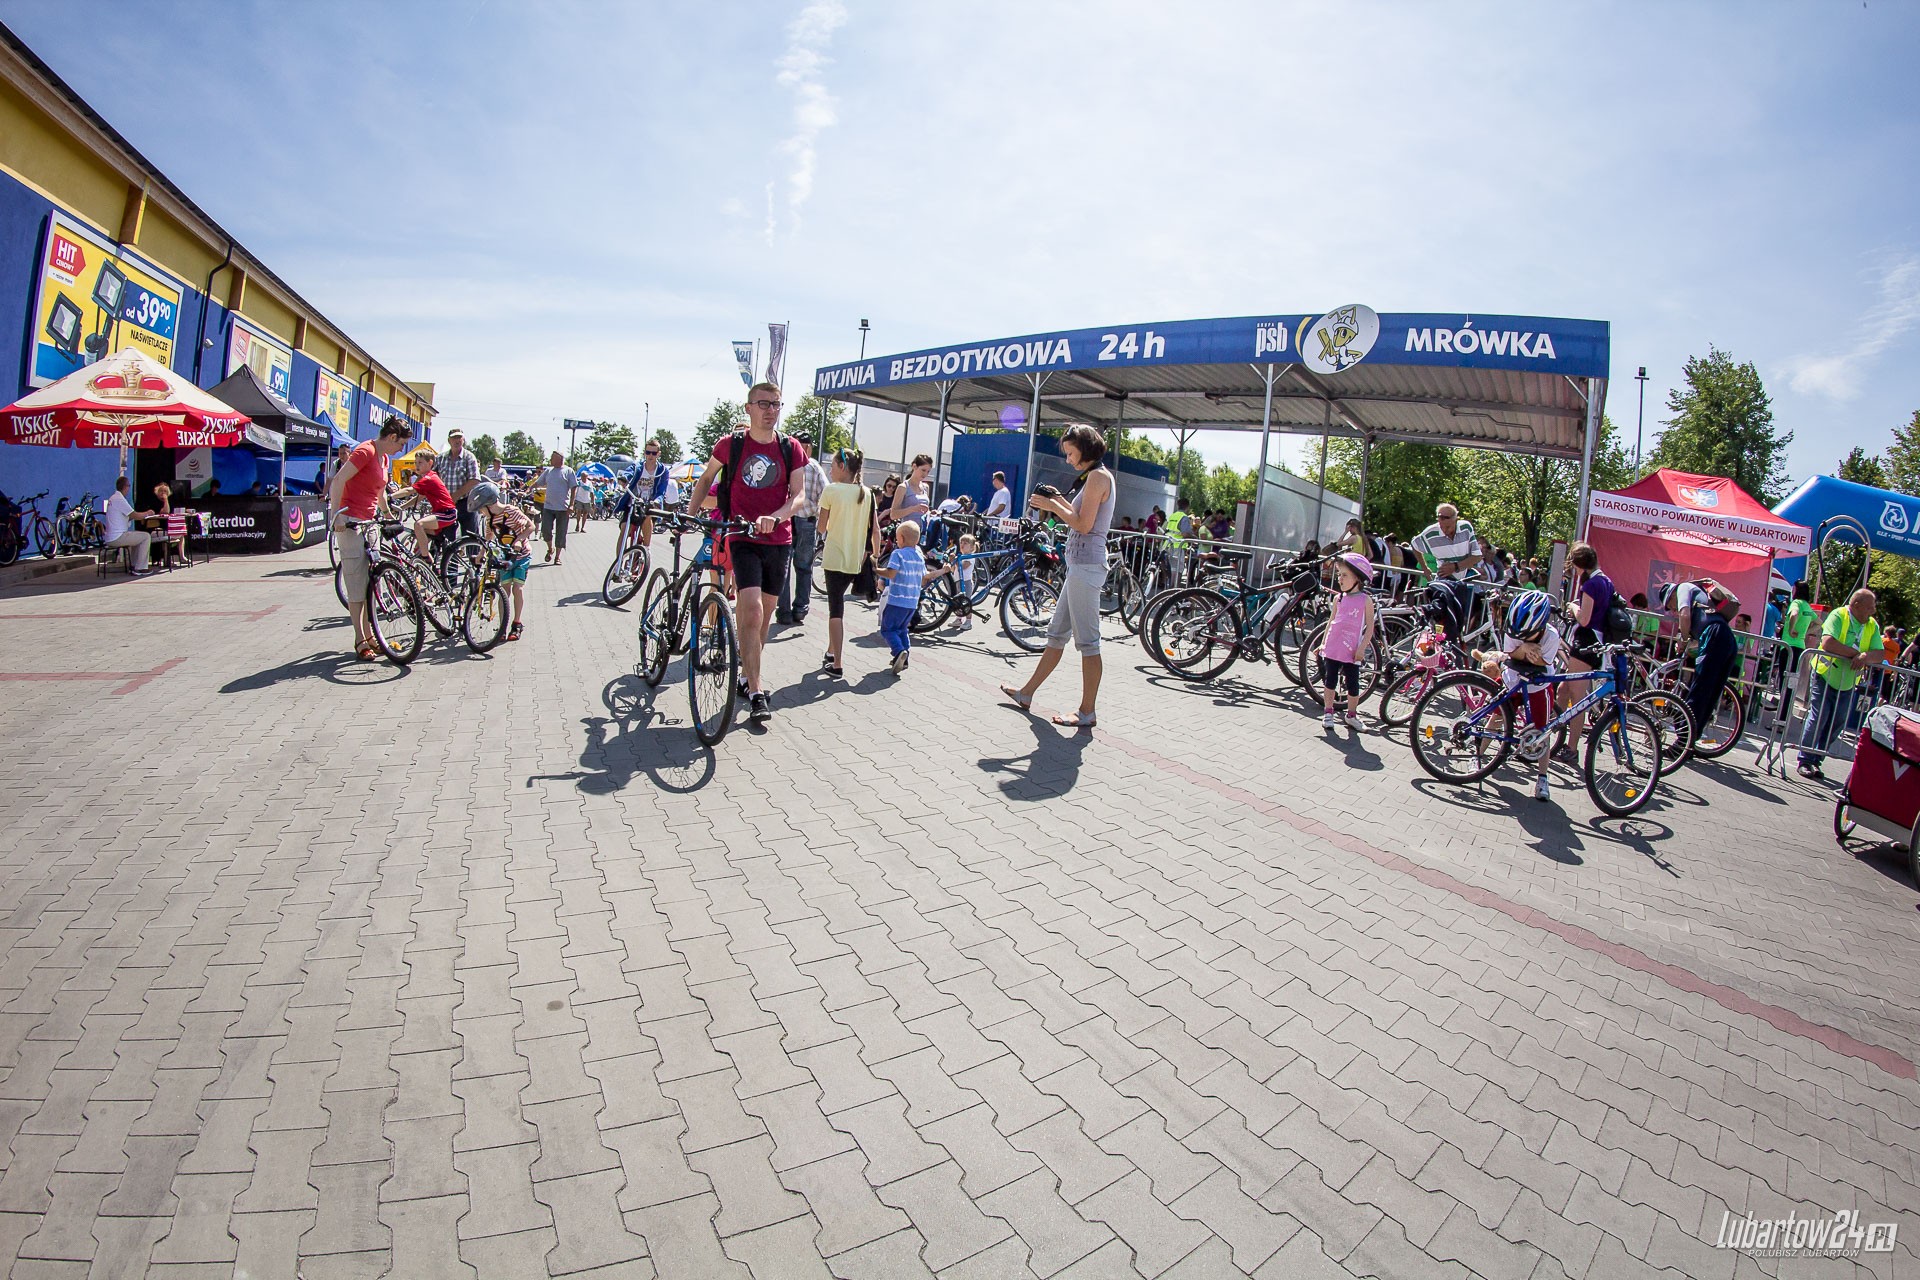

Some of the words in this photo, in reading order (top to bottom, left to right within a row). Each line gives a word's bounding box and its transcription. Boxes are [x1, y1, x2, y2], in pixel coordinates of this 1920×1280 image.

[57, 240, 77, 263] HIT
[1255, 321, 1288, 358] psb
[1404, 321, 1557, 359] MRÓWKA
[158, 354, 167, 366] LED
[816, 364, 875, 392] MYJNIA
[889, 338, 1072, 381] BEZDOTYKOWA
[11, 411, 59, 435] TYSKIE
[202, 415, 240, 434] TYSKIE
[1594, 498, 1659, 517] STAROSTWO
[1661, 510, 1725, 529] POWIATOWE
[1727, 521, 1738, 531] W
[1739, 523, 1807, 545] LUBARTOWIE
